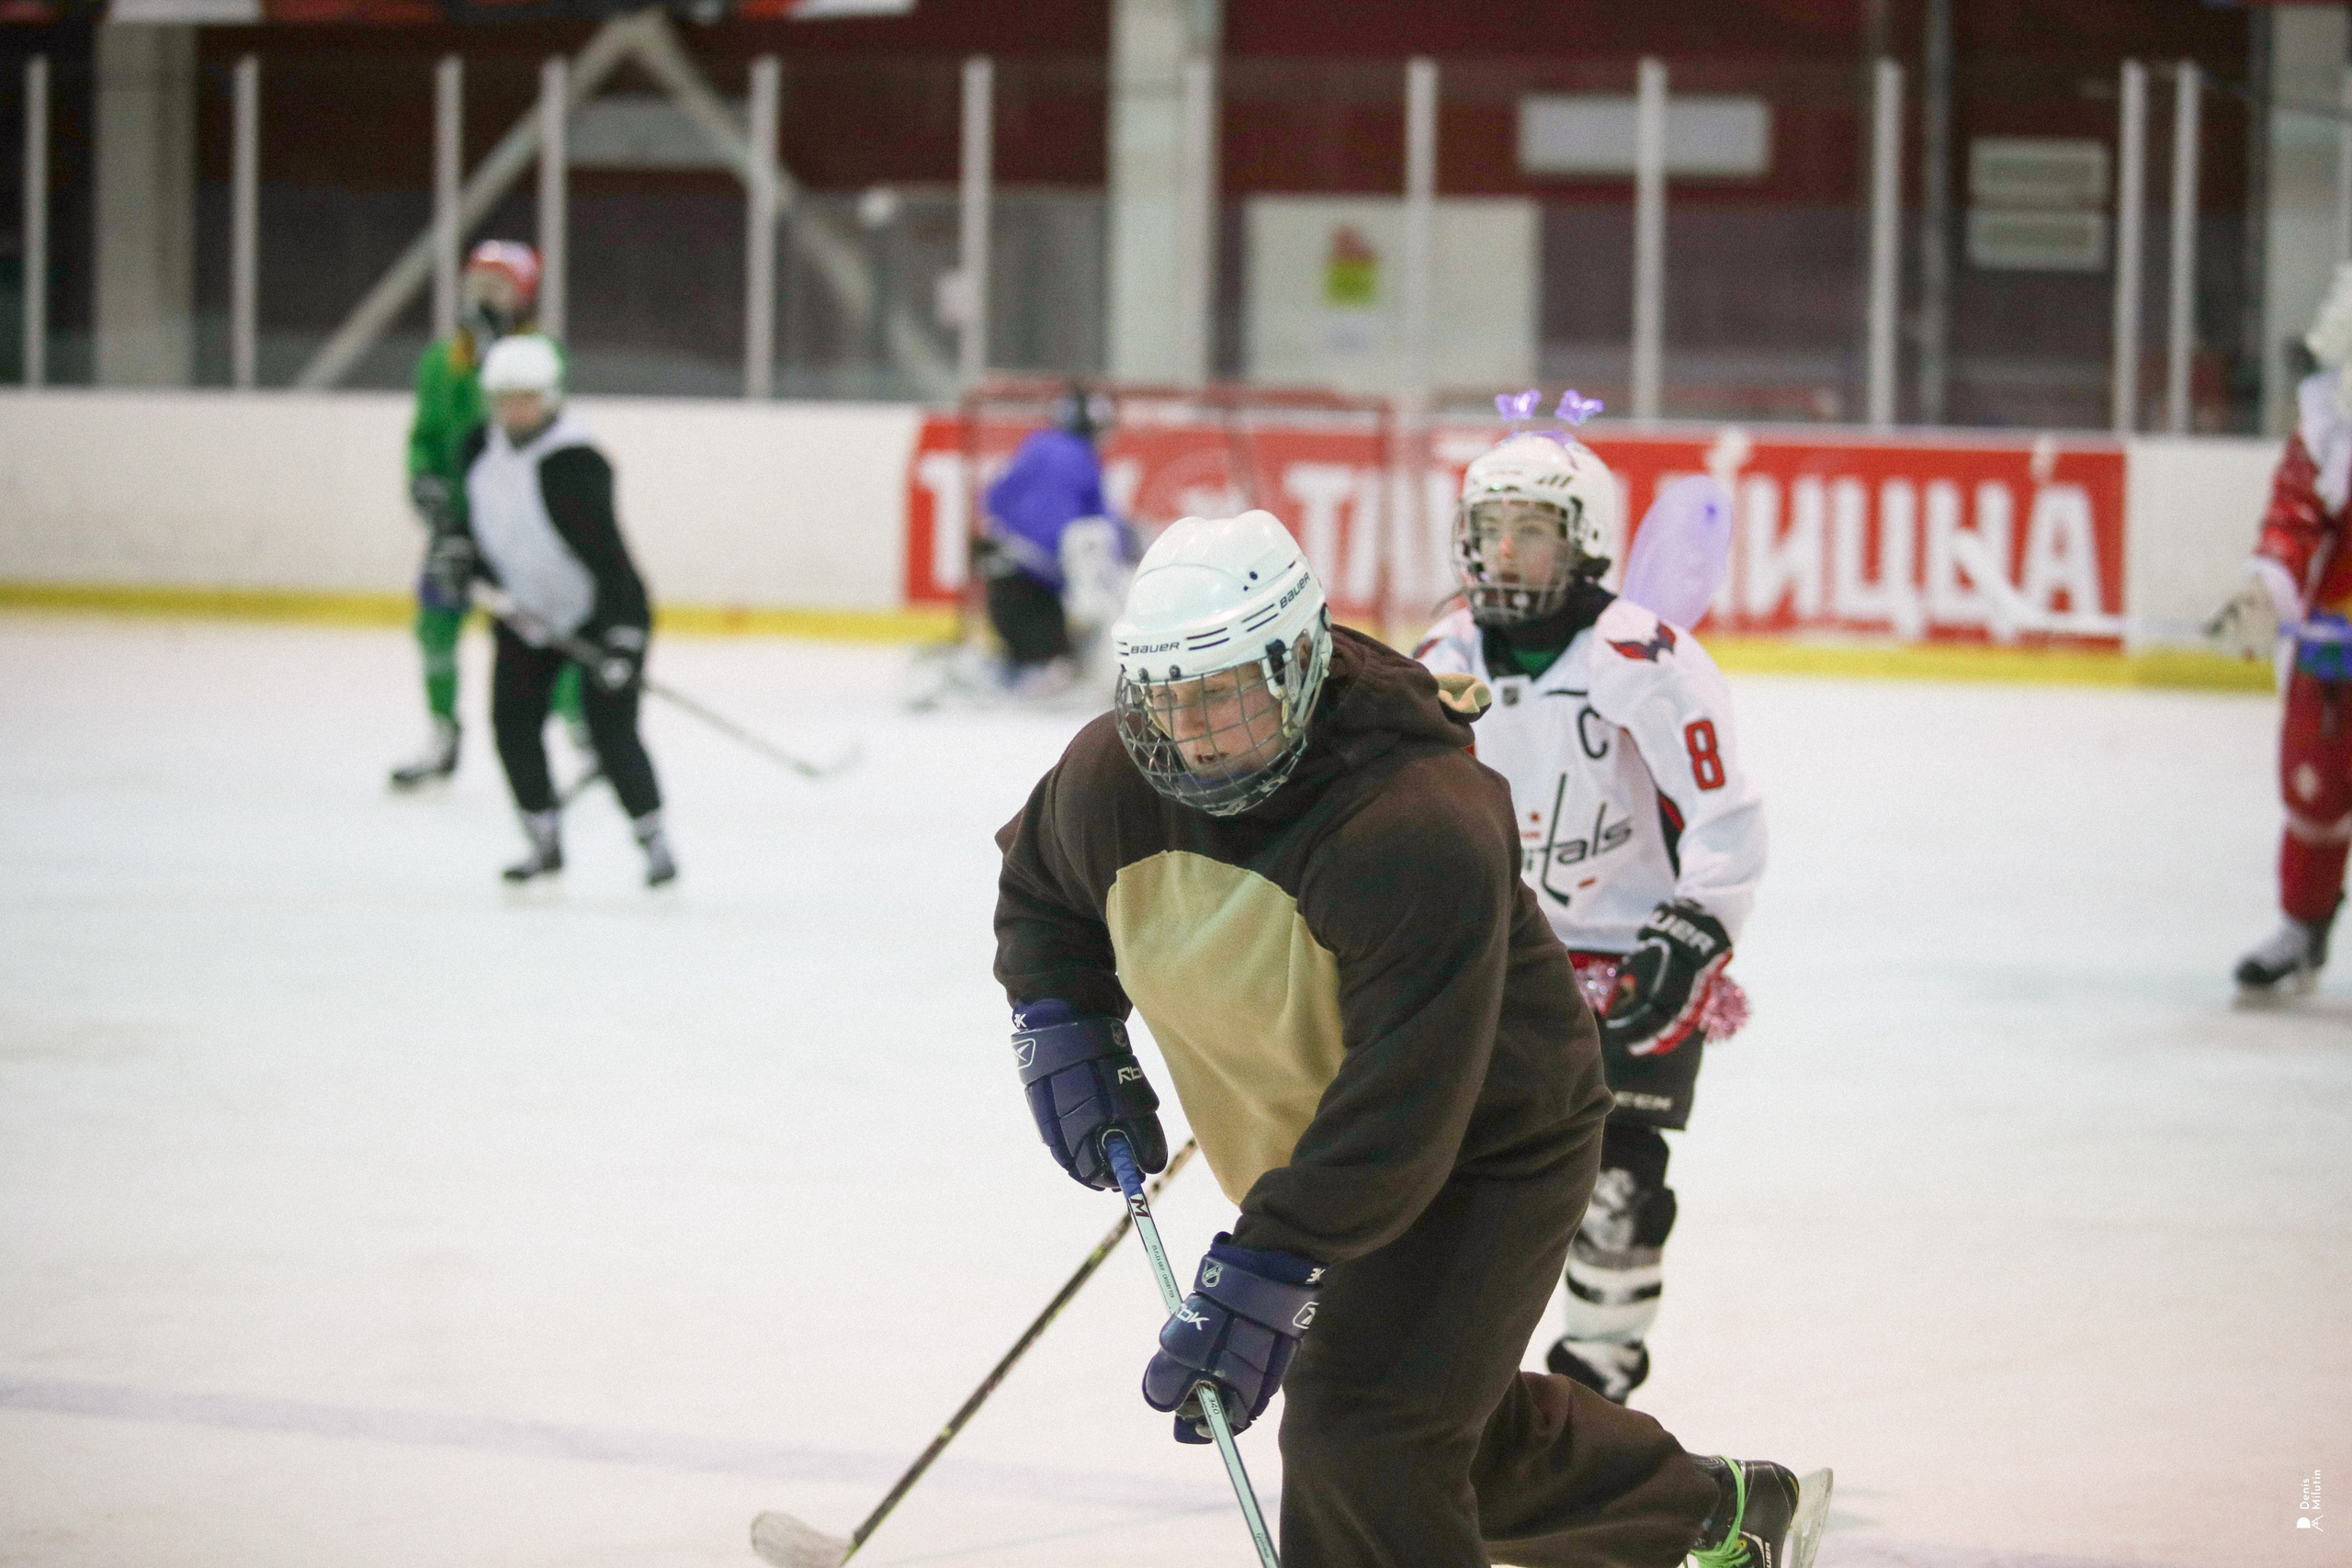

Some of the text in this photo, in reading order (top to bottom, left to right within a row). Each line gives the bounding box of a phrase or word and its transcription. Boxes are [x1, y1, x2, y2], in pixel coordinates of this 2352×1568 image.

[1280, 571, 1311, 609] BAUER
[1130, 642, 1180, 654] BAUER
[1577, 705, 1608, 760] C
[1684, 718, 1725, 792] 8
